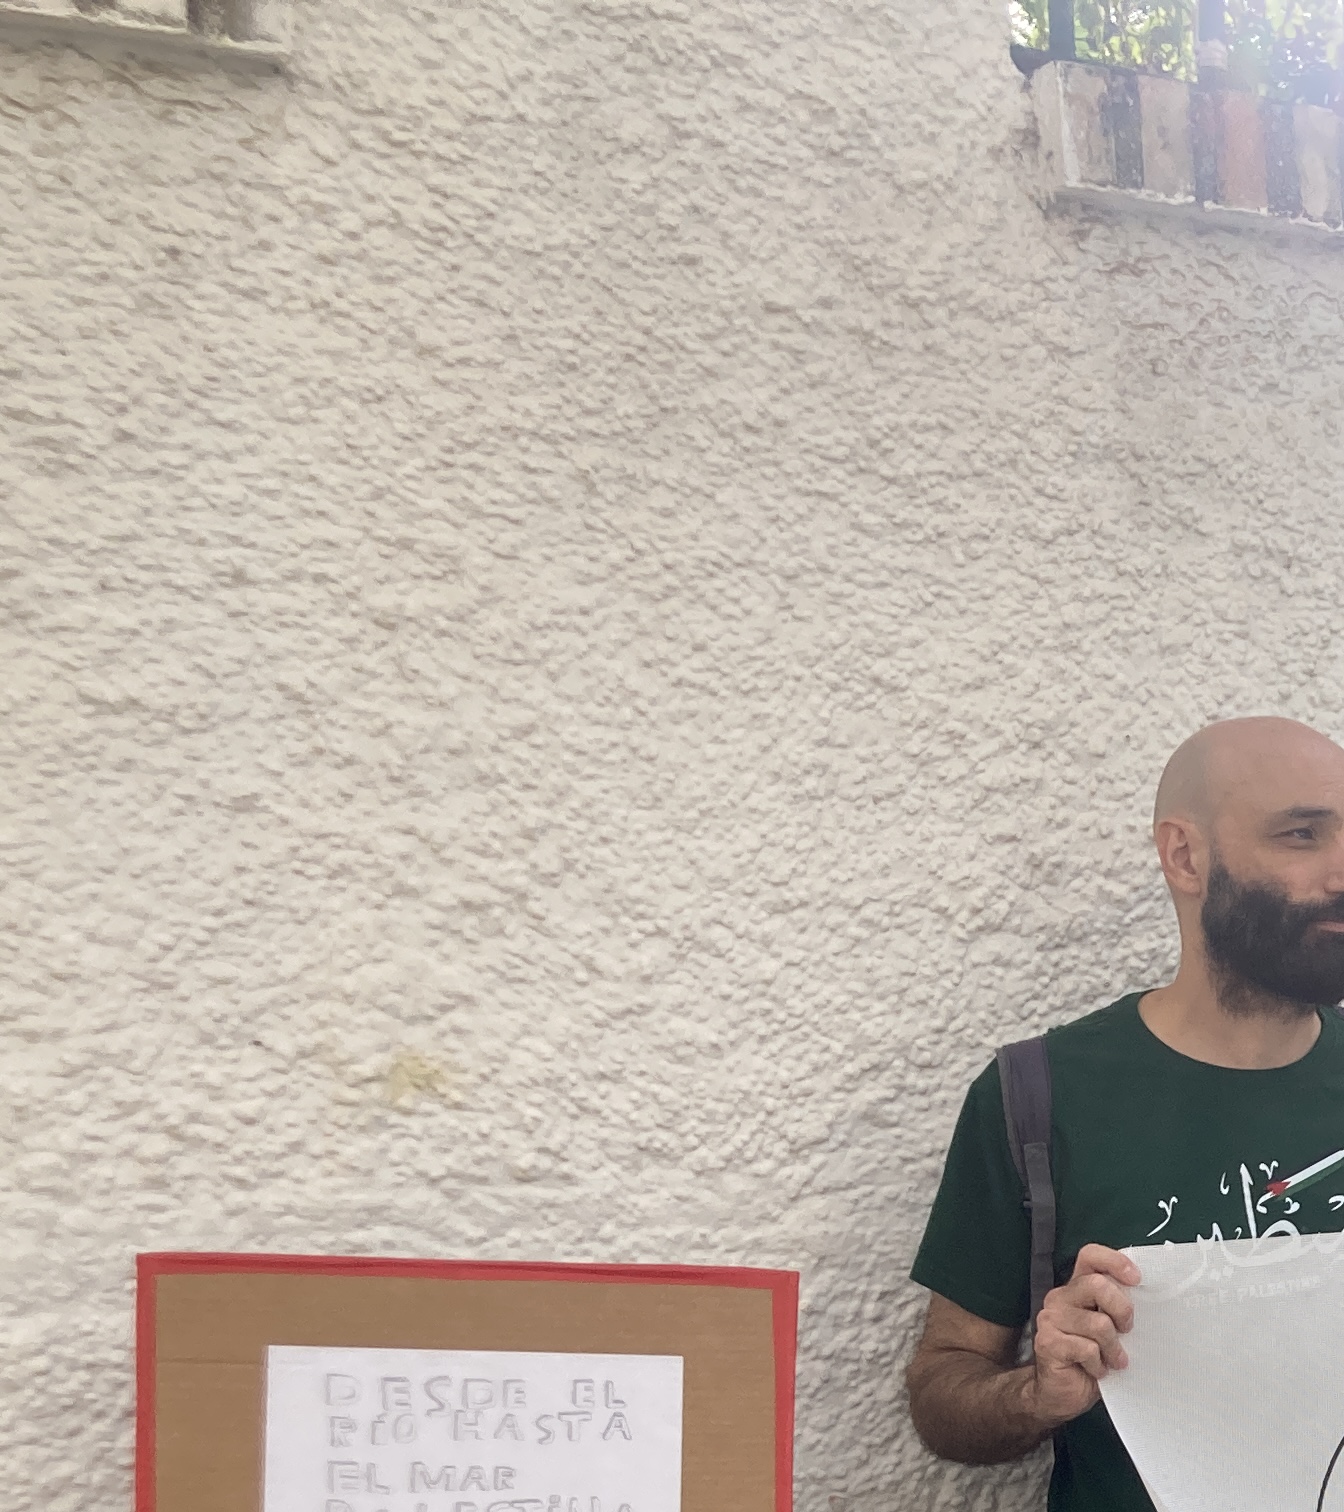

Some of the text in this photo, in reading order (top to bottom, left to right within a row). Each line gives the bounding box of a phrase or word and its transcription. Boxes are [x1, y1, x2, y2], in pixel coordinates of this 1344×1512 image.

[325, 1373, 627, 1417] DESDE EL
[451, 1410, 634, 1445] HASTA
[327, 1459, 517, 1495] EL MAR
